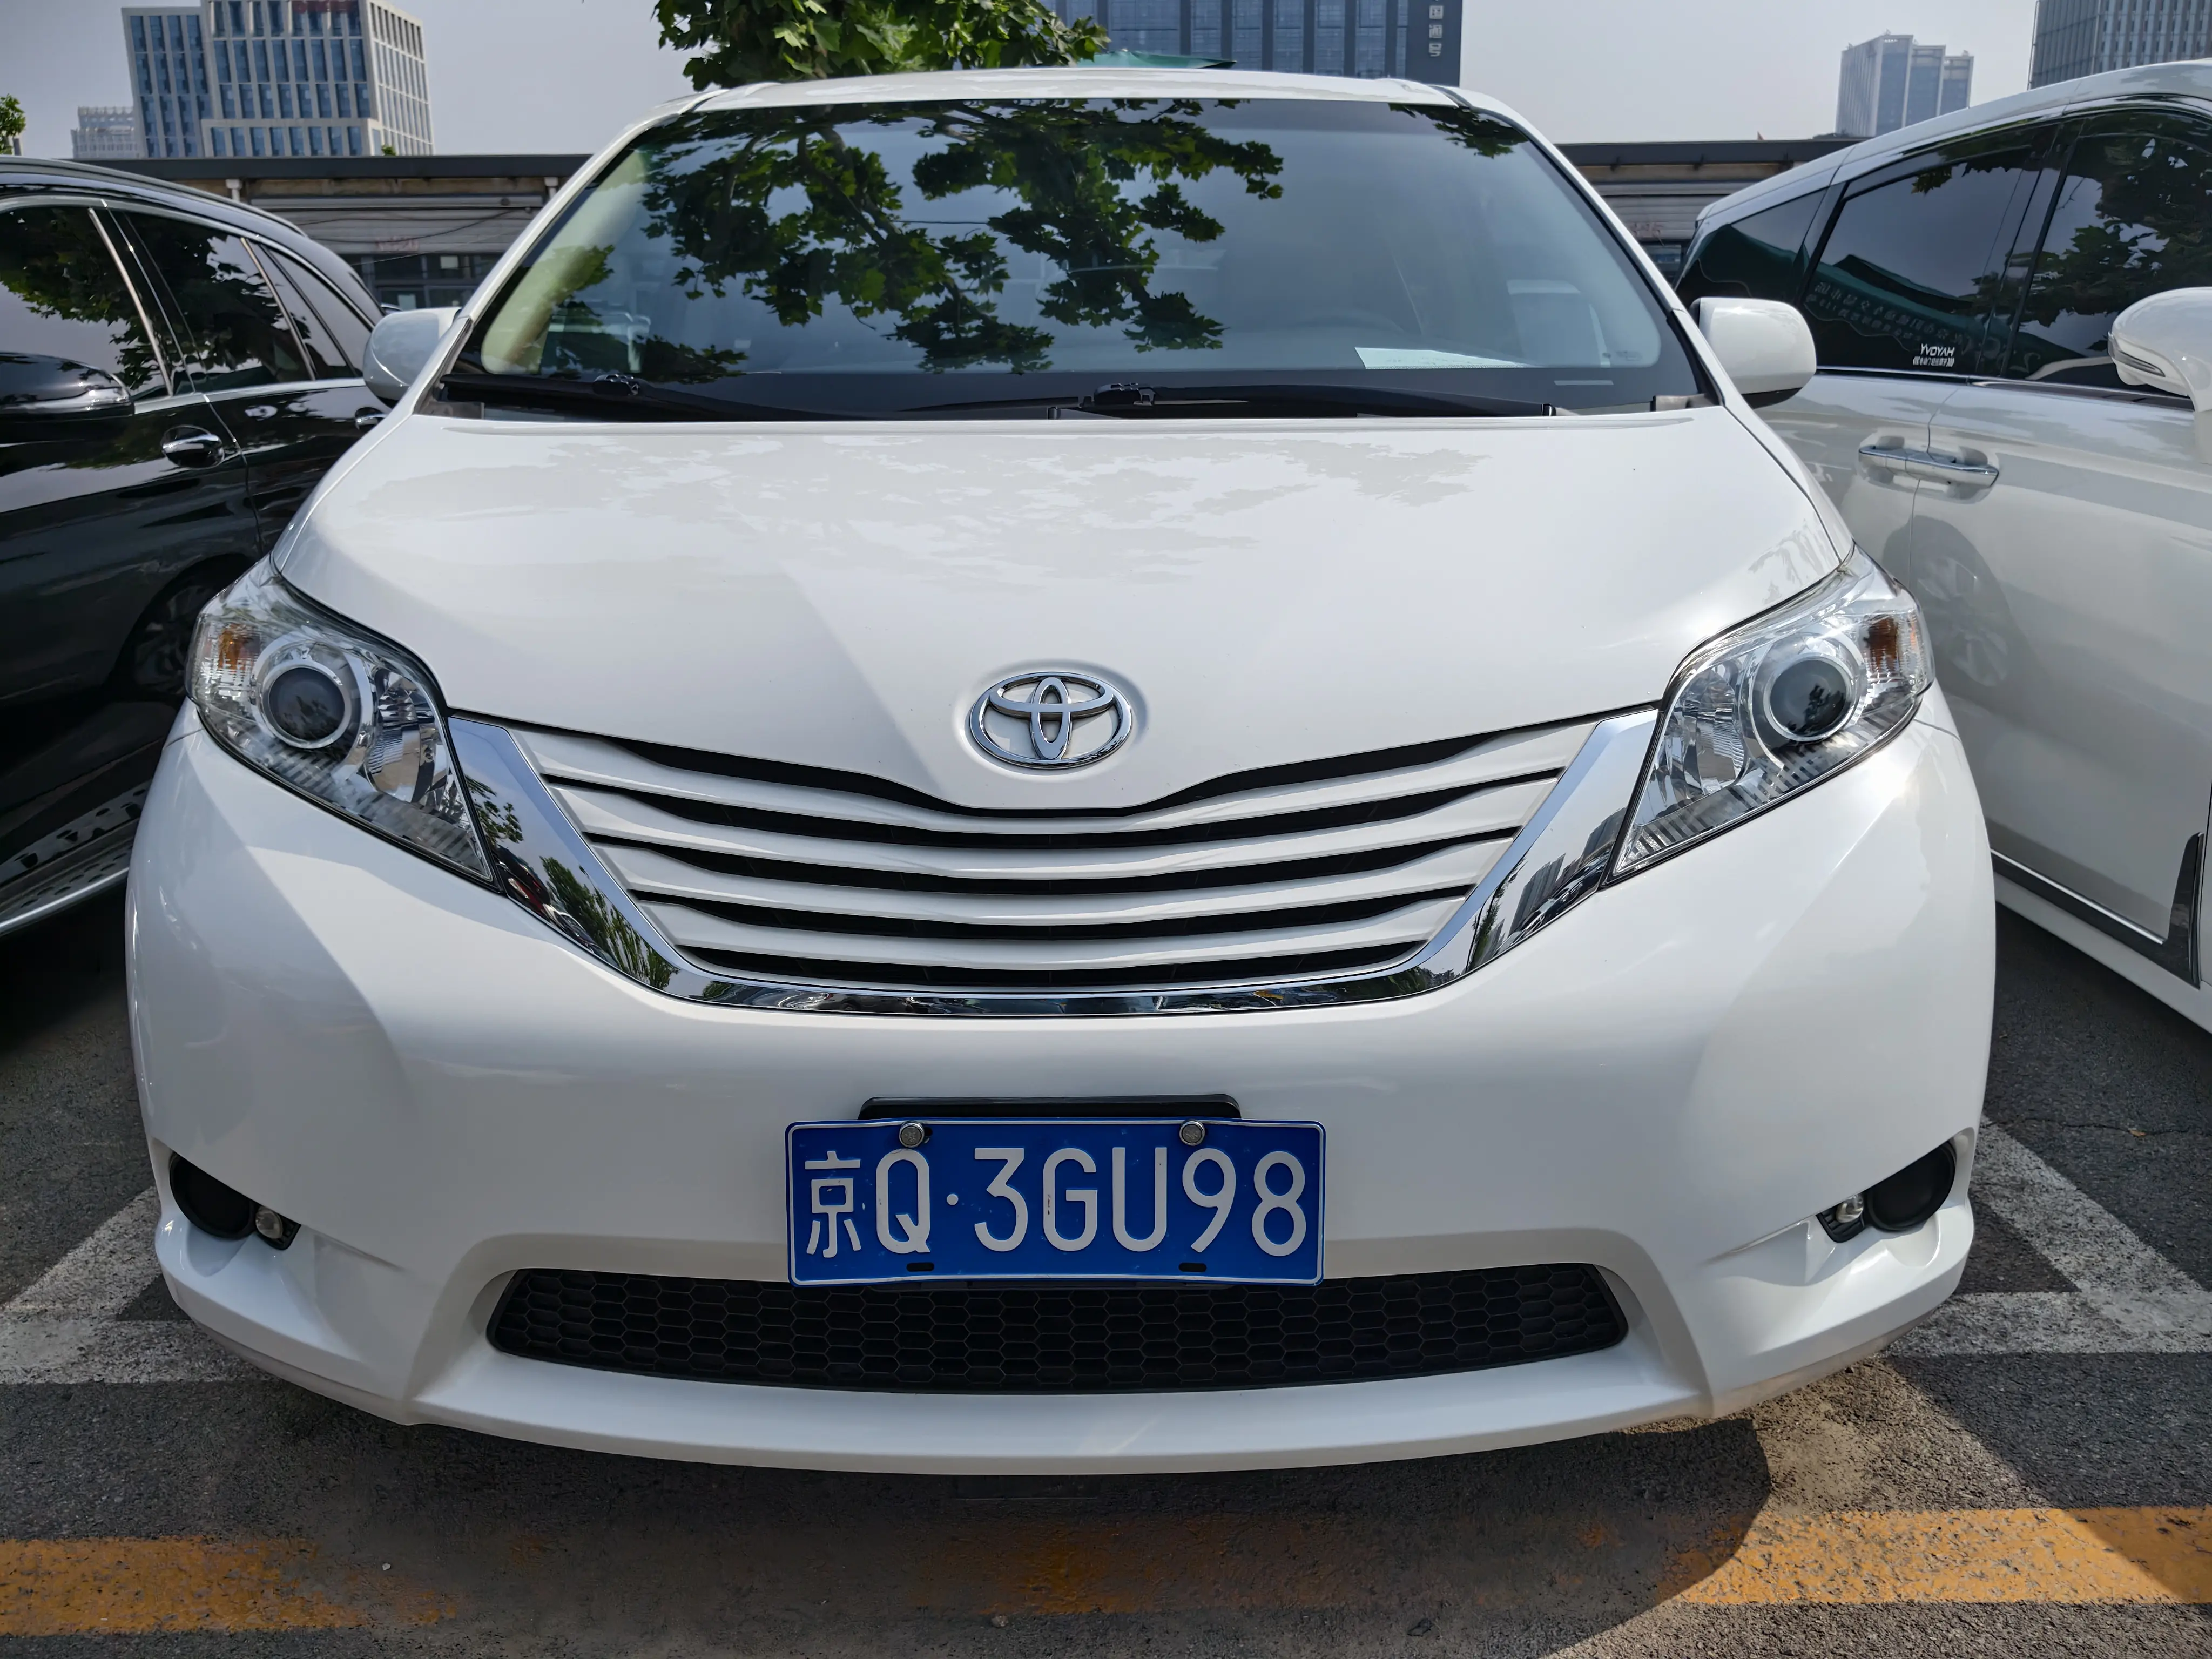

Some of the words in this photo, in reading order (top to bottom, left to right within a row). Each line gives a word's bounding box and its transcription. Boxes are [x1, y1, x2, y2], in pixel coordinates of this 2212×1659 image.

[1429, 0, 1444, 57] 国通号
[805, 1147, 1307, 1258] 京Q·3GU98
